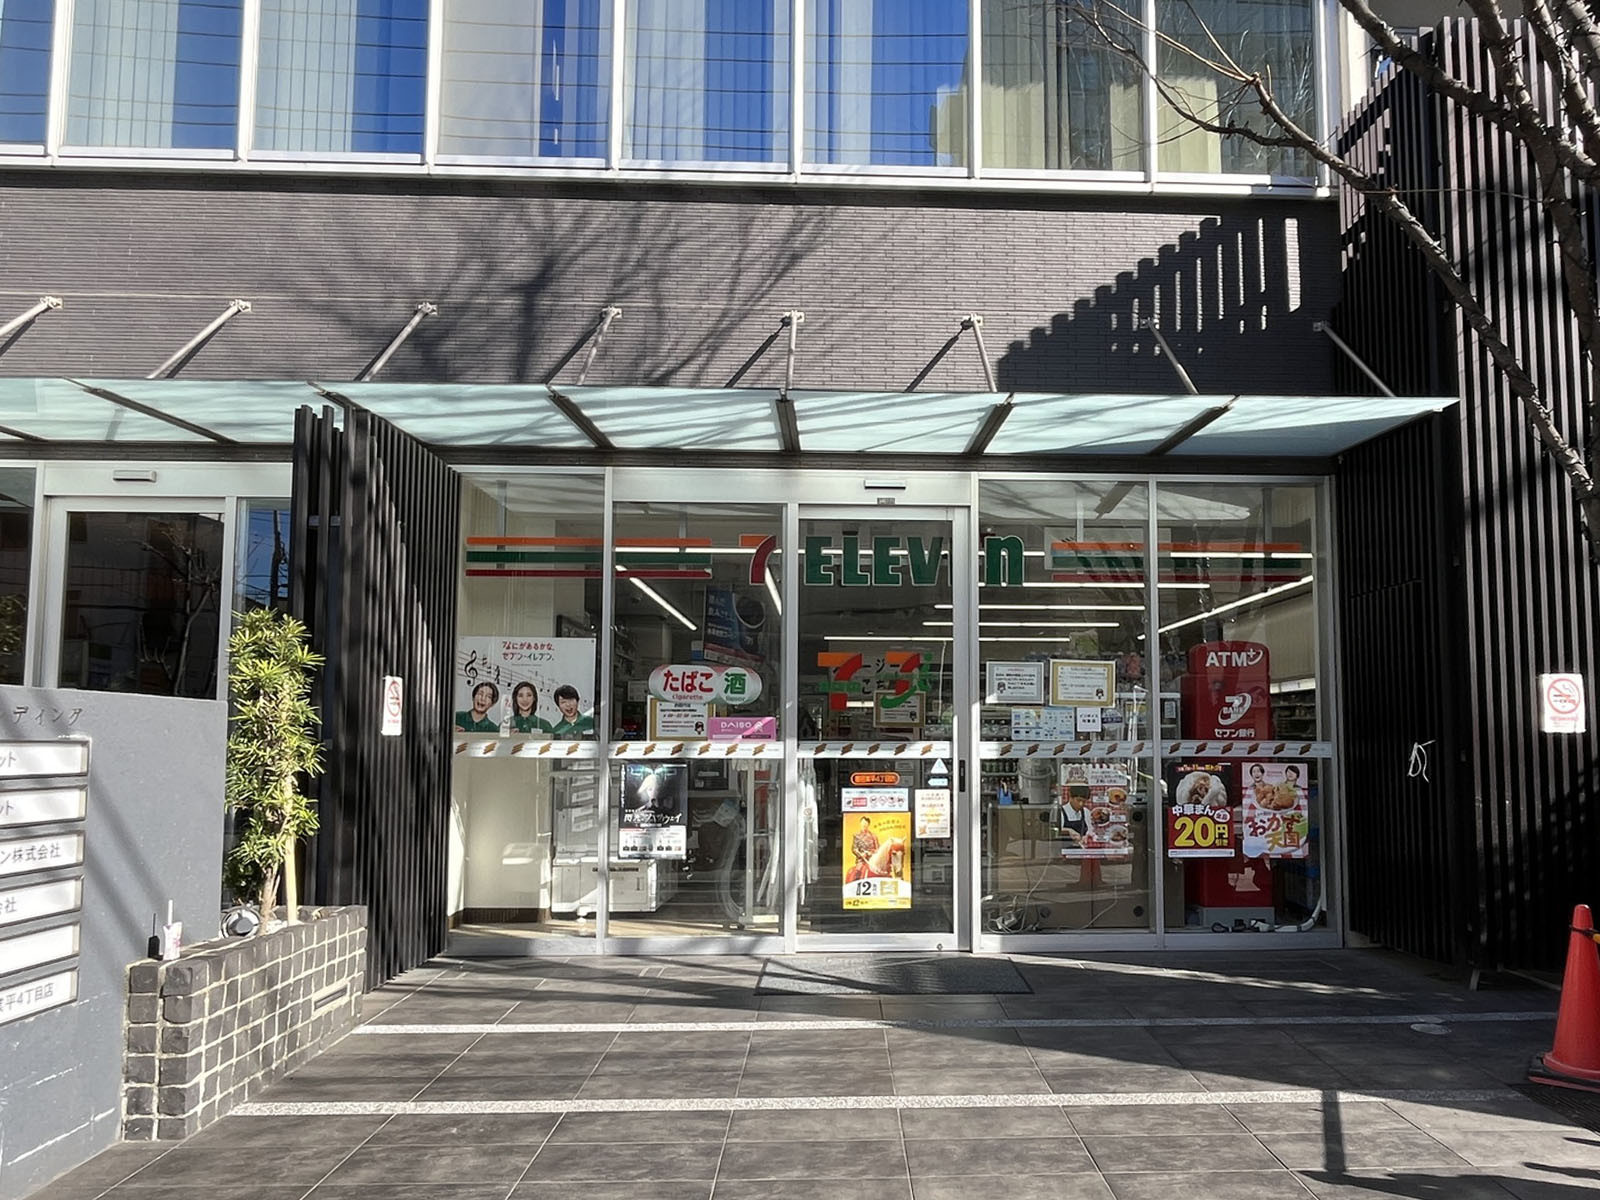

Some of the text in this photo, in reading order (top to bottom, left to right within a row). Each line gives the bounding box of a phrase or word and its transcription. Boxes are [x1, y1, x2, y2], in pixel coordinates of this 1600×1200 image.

[738, 534, 1024, 586] 7 ELEVn
[663, 670, 747, 695] たばこ 酒
[720, 721, 752, 729] DAISO
[1172, 803, 1215, 816] 中華まん
[0, 842, 61, 864] ン株式会社
